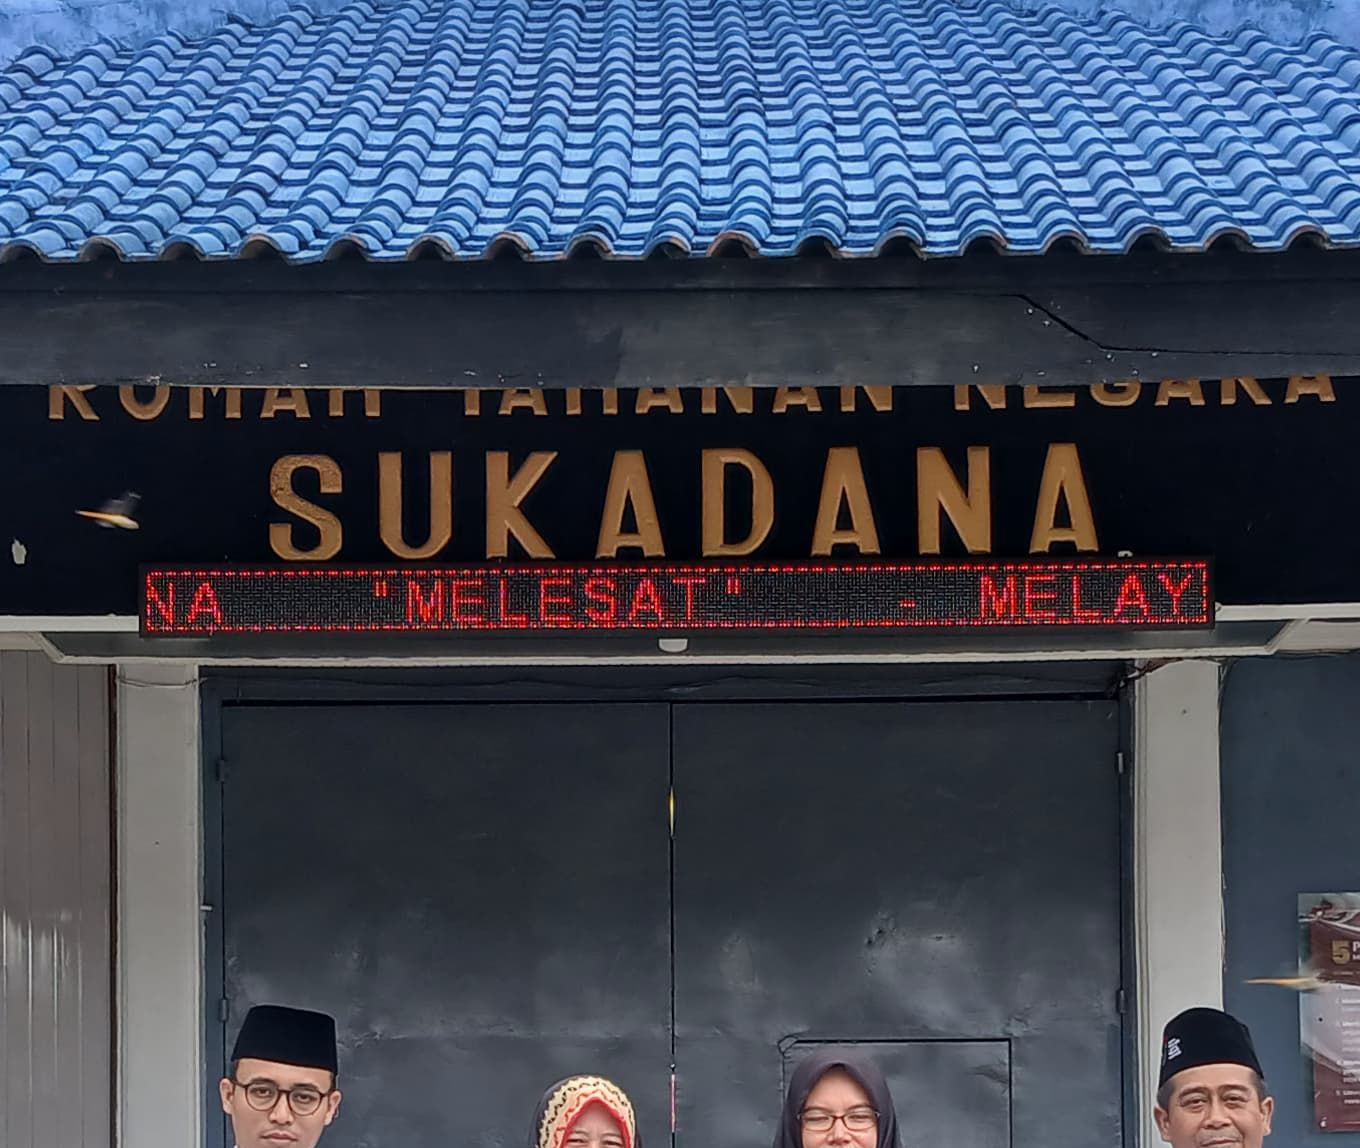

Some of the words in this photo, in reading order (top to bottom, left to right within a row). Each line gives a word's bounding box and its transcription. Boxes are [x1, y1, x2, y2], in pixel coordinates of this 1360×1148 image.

[269, 442, 1100, 561] SUKADANA
[374, 576, 739, 627] "MELESAT"
[979, 572, 1192, 619] MELAY
[1332, 940, 1350, 964] 5
